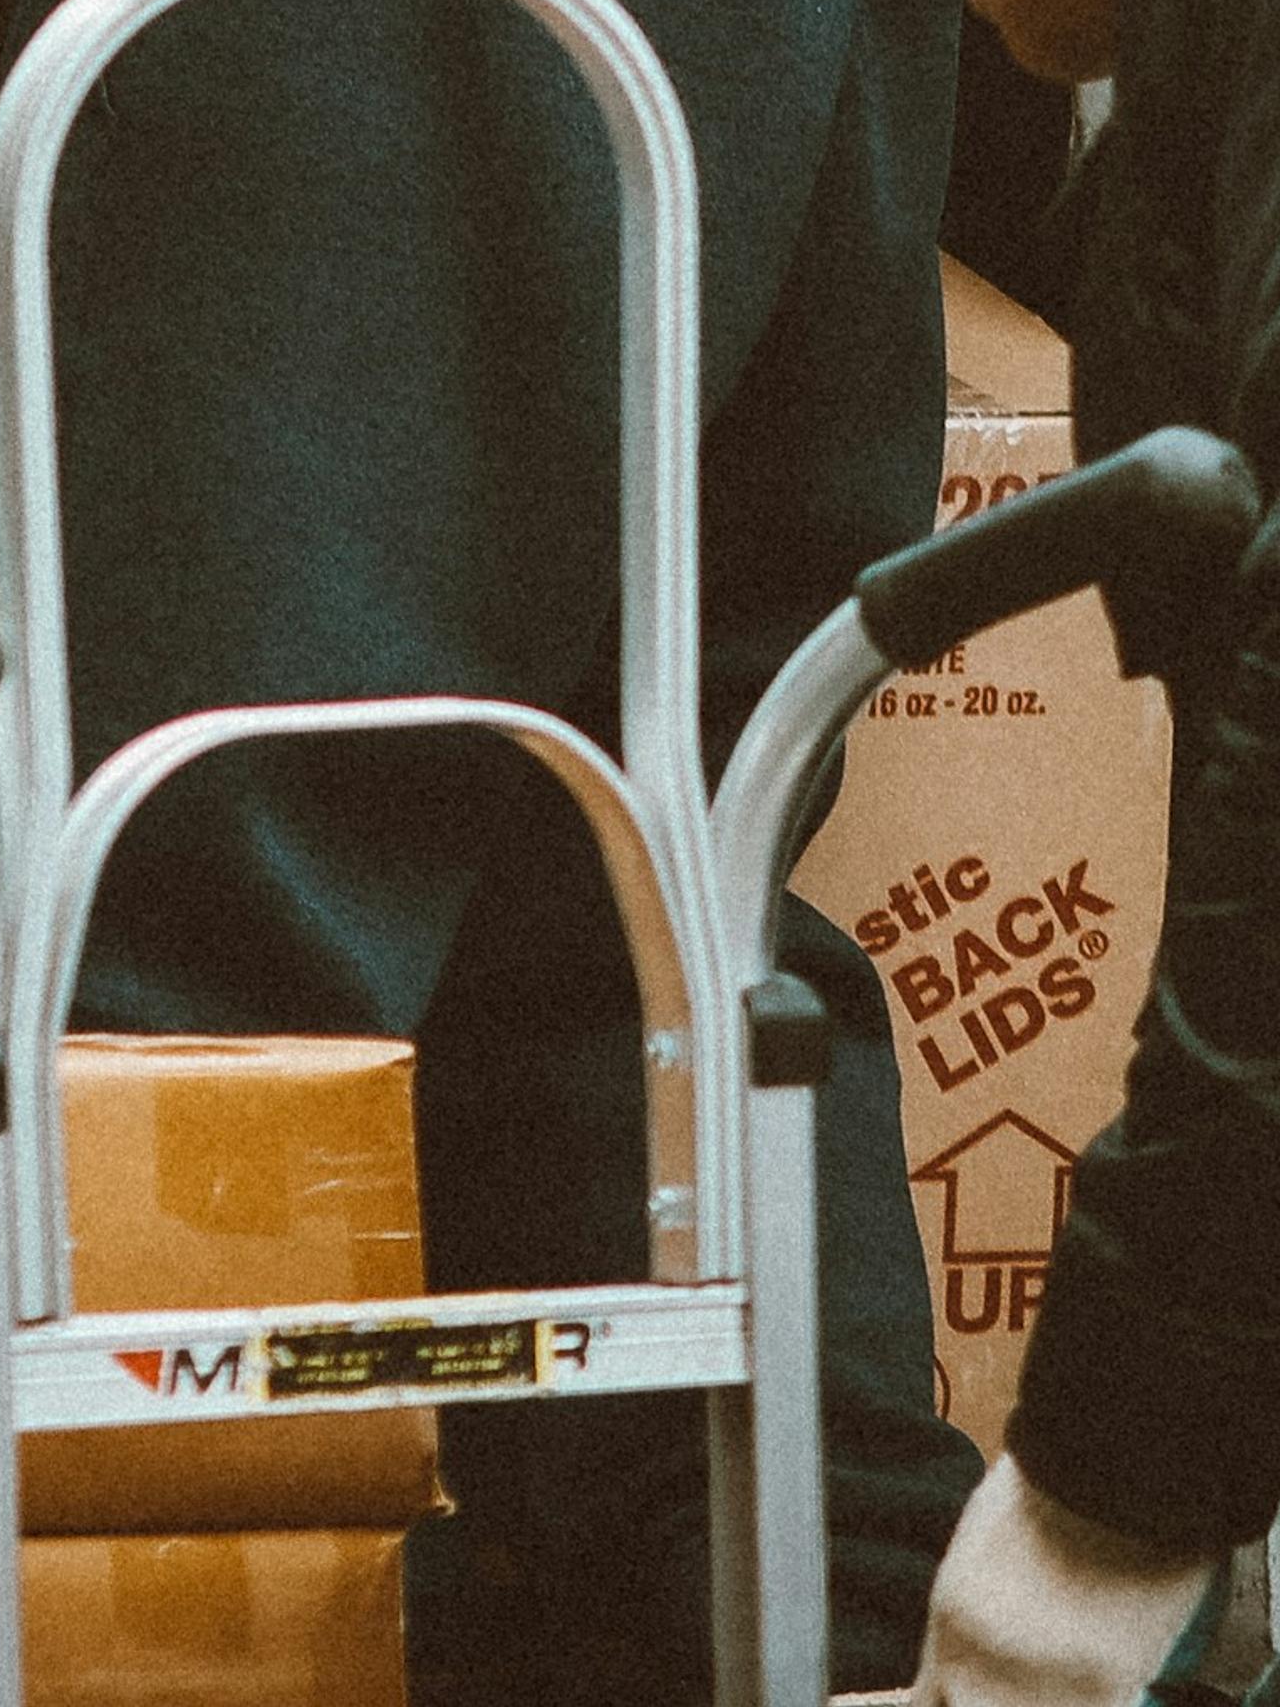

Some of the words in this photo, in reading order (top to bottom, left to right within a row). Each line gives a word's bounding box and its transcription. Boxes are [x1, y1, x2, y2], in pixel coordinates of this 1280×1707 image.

[905, 692, 937, 717] oz
[963, 685, 998, 716] 20
[1007, 690, 1046, 716] oz.
[890, 858, 1115, 1024] BACK
